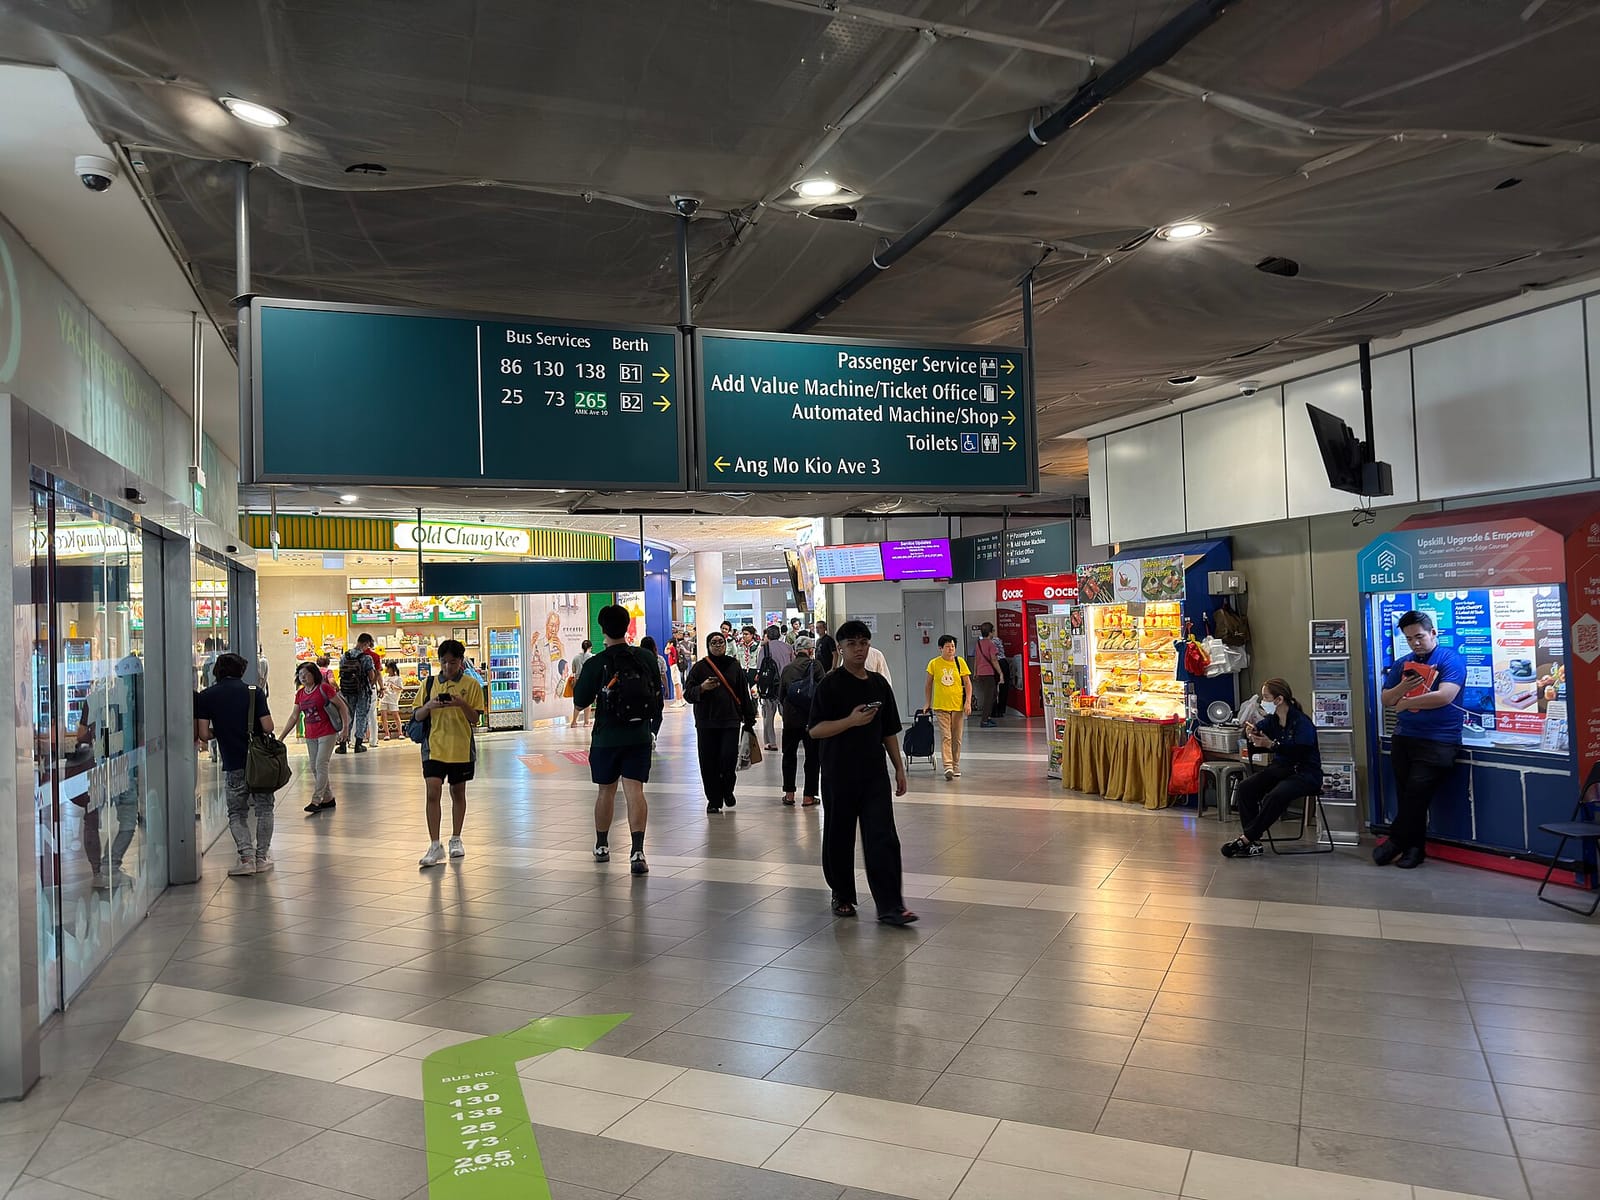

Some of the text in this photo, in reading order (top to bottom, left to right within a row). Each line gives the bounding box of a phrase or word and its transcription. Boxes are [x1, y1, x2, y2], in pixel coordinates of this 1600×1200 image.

[506, 329, 591, 349] Bus Services
[612, 337, 649, 352] Berth
[500, 358, 642, 382] 86 130 138 B1
[838, 351, 977, 375] Passenger Service
[711, 374, 978, 401] Add Value Machine/Ticket Office
[501, 388, 642, 411] 25 73 265 B2
[791, 402, 999, 427] Automated Machine/Shop
[906, 434, 958, 452] Toilets
[734, 456, 881, 477] Ang Mo Kio Ave 3
[411, 525, 520, 551] Old Chang Kee
[1013, 529, 1042, 539] Passenger Service
[1031, 538, 1046, 546] Machine
[1417, 529, 1536, 549] Upskill, Upgrade & Empower
[1370, 572, 1405, 585] BELLS
[1008, 589, 1023, 598] OCBC
[1055, 587, 1079, 597] OCBC
[441, 1070, 499, 1083] BUS NO.
[456, 1082, 490, 1095] 86
[449, 1093, 500, 1108] 130
[450, 1106, 503, 1121] 138
[460, 1121, 497, 1136] 25
[461, 1136, 500, 1151] 73
[454, 1150, 513, 1169] 265
[453, 1159, 516, 1177] (Ave 10)
